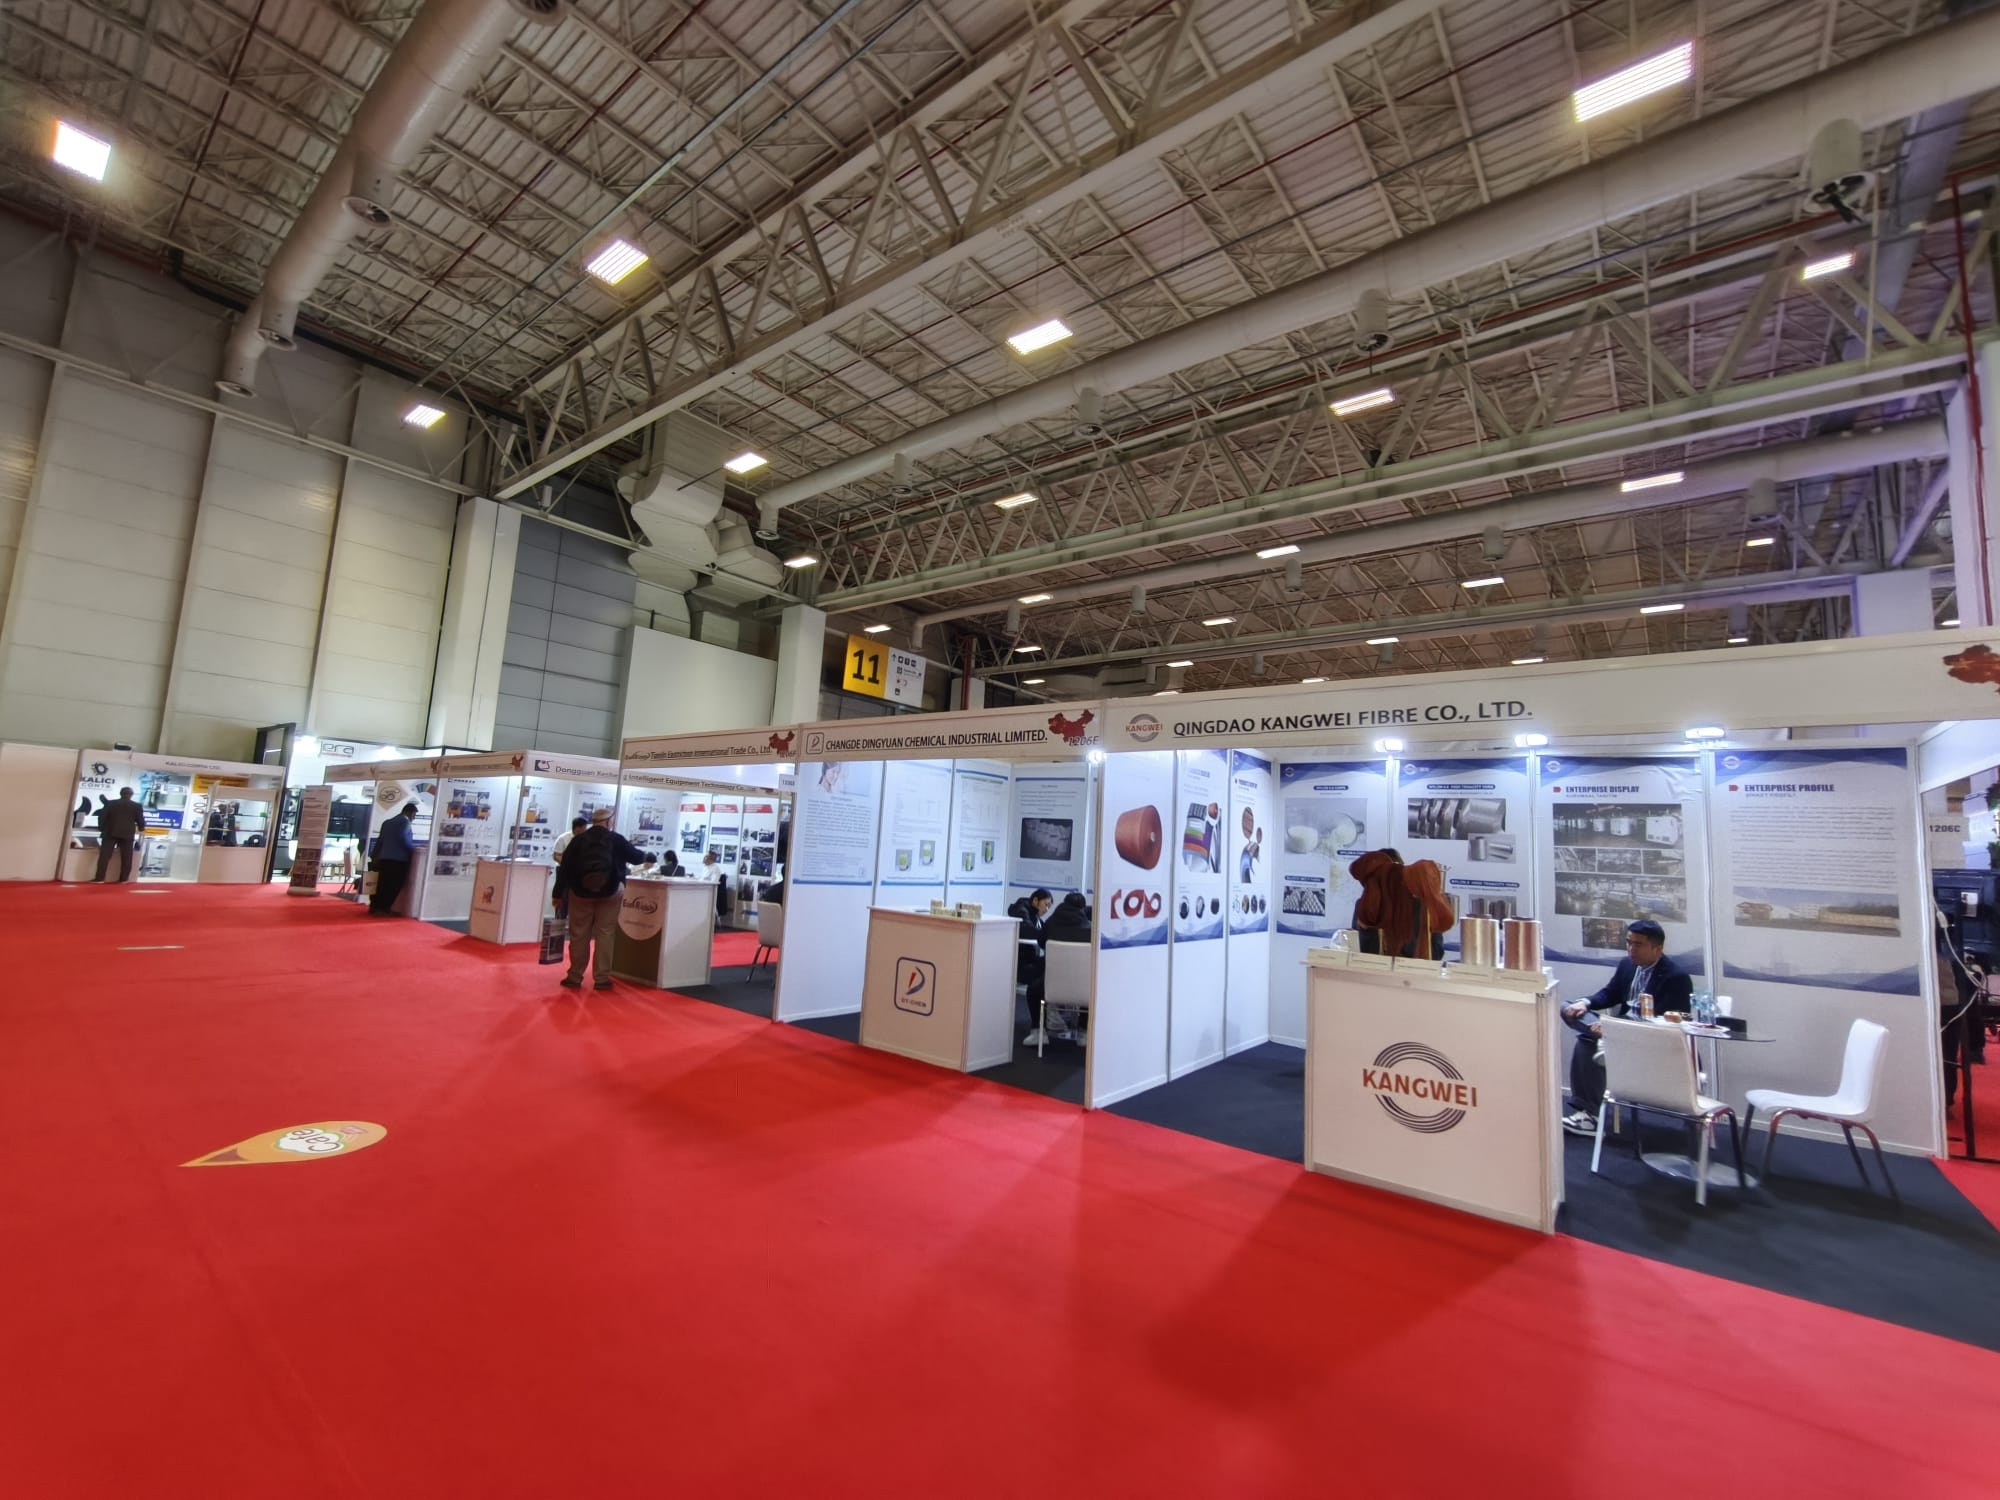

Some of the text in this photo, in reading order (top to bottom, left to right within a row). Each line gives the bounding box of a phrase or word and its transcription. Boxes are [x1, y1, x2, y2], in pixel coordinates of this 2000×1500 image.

[853, 649, 880, 684] 11
[1125, 723, 1163, 733] KANGWEI
[1173, 701, 1533, 737] QINGDAO KANGWEI FIBRE CO., LTD.
[825, 729, 1048, 751] CHANGDE DINGYUAN CHEMICAL INDUSTRIAL LIMITED.
[555, 766, 596, 777] Dongguan
[665, 777, 700, 788] Equipment
[1744, 784, 1836, 792] ENTERPRISE PROFILE
[1362, 1068, 1478, 1108] KANGWEI
